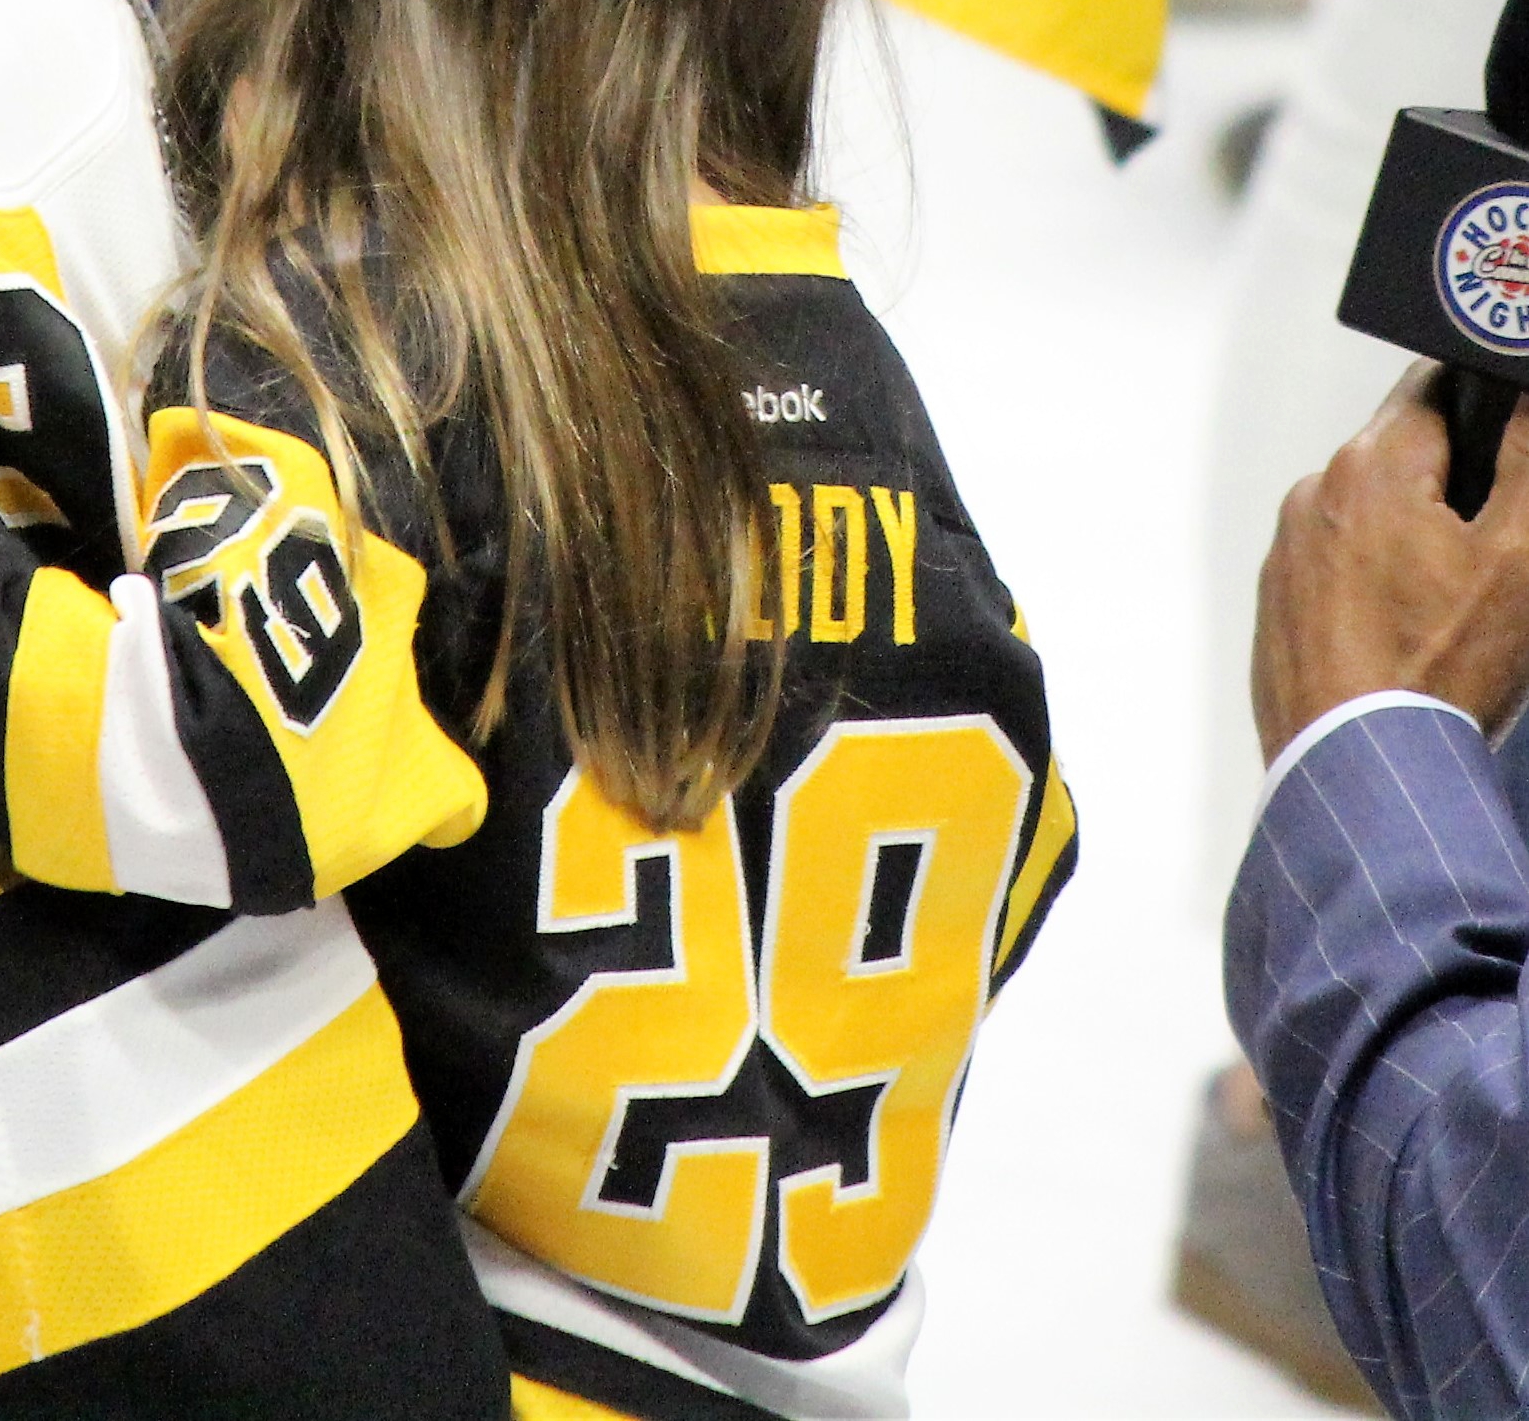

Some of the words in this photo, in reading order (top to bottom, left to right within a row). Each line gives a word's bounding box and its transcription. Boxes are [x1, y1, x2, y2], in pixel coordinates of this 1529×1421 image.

[1461, 202, 1529, 250] HOC
[1454, 271, 1529, 334] NIGH
[456, 712, 1035, 1327] 29
